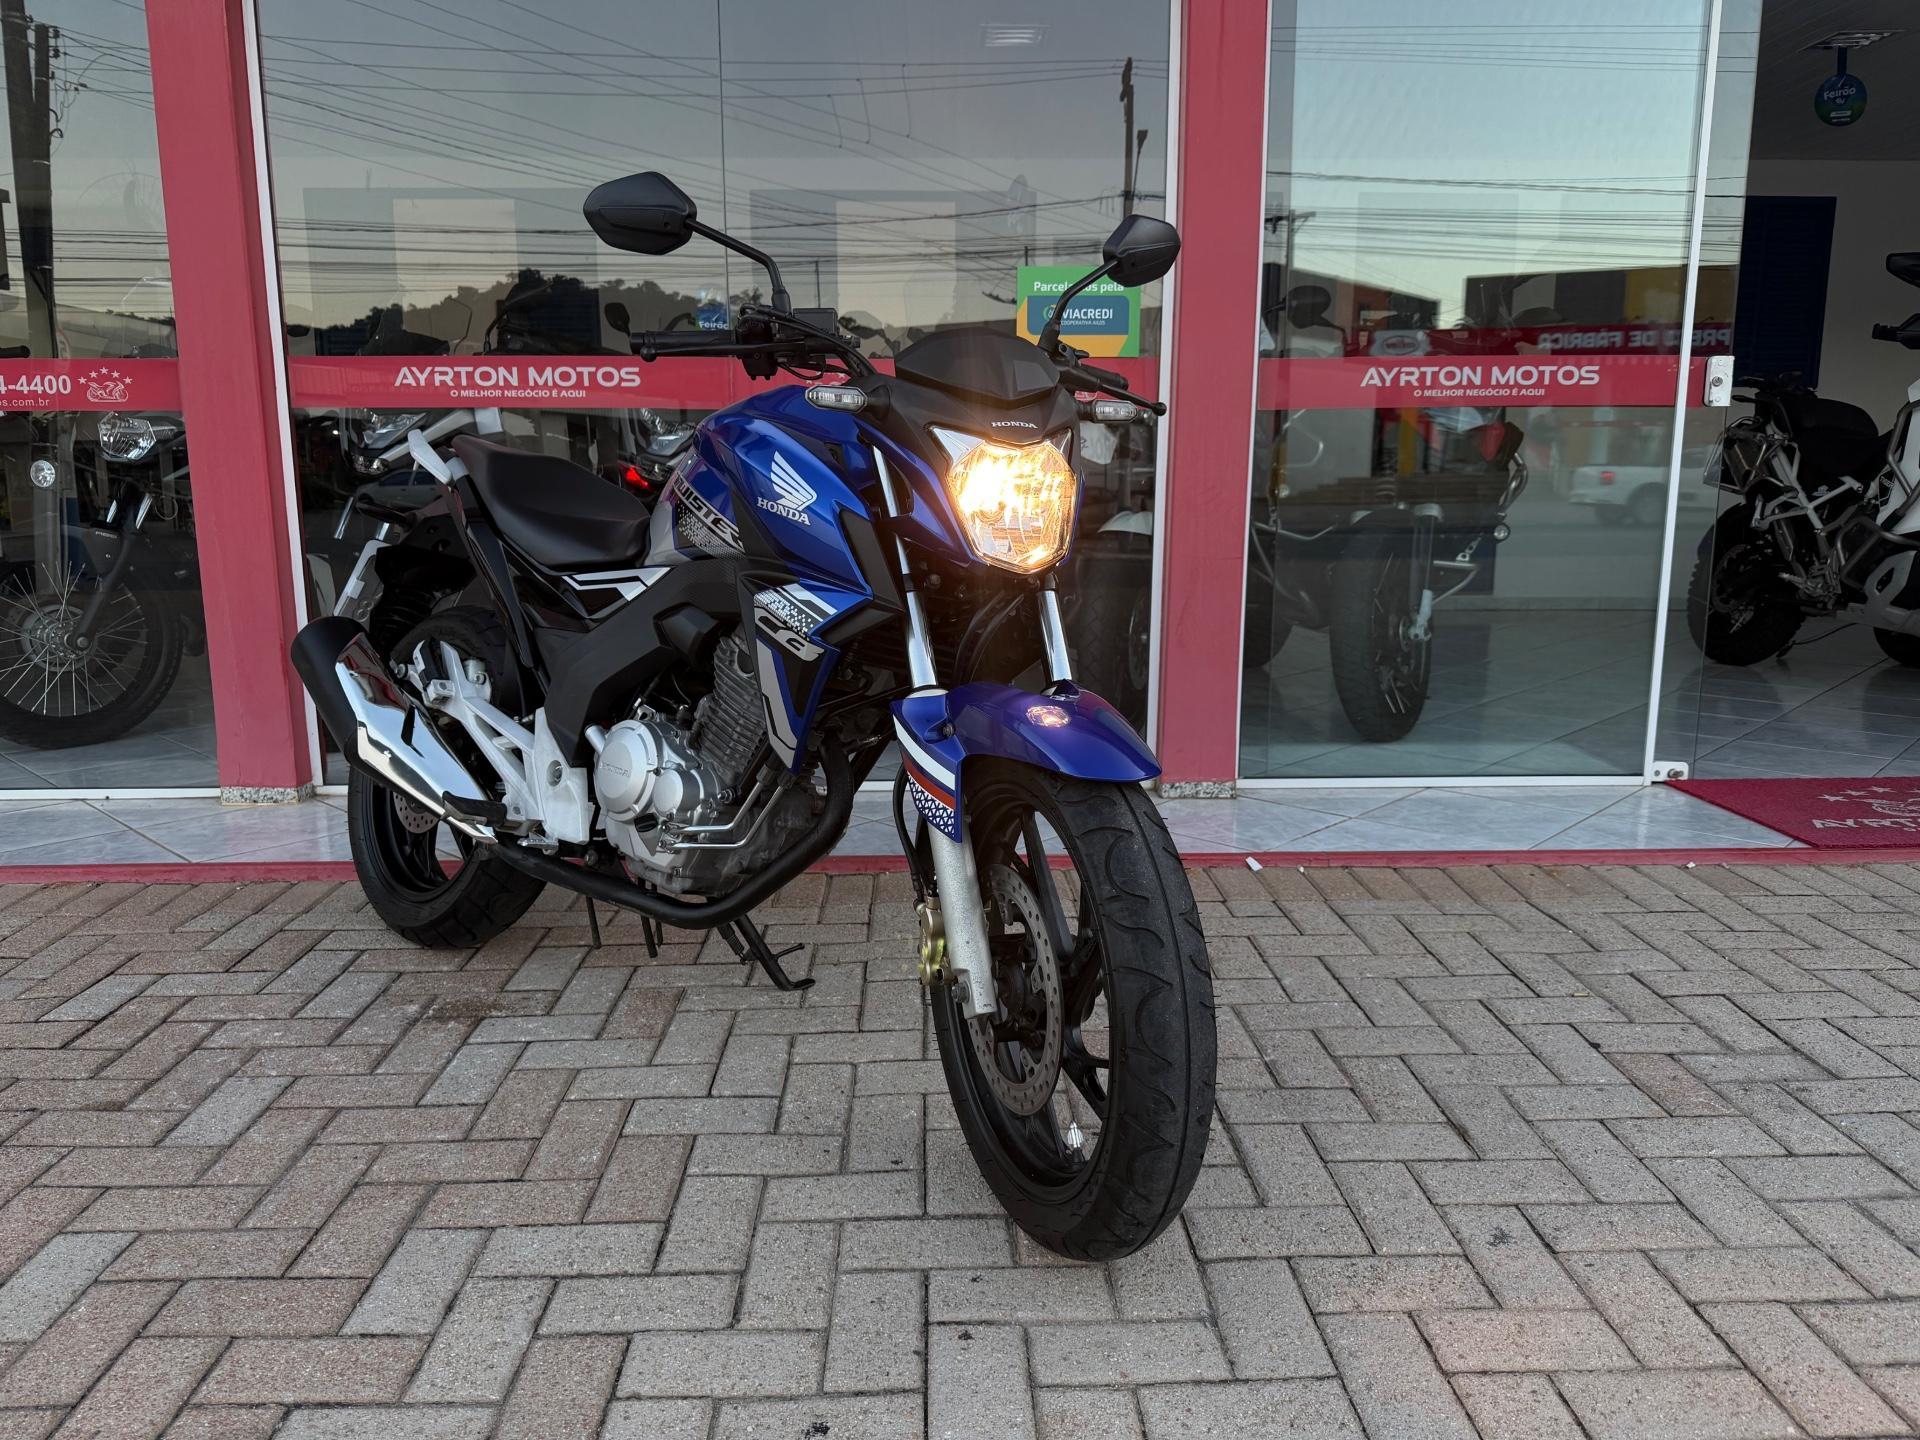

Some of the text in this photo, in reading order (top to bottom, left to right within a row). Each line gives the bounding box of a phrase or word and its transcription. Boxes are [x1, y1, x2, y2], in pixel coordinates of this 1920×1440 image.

[1034, 280, 1125, 294] Parcelos pela
[1062, 309, 1113, 319] VIACREDI
[394, 366, 641, 387] AYRTON MOTOS
[1360, 365, 1601, 387] AYRTON MOTOS
[450, 387, 586, 398] O MELHOR NEGÓCIO É AQUI
[1413, 386, 1545, 397] O MELHOR NEGÓCIO É AQUI
[0, 397, 49, 407] s.com.br
[757, 497, 810, 526] HONDA
[1812, 818, 1920, 828] AYRT
